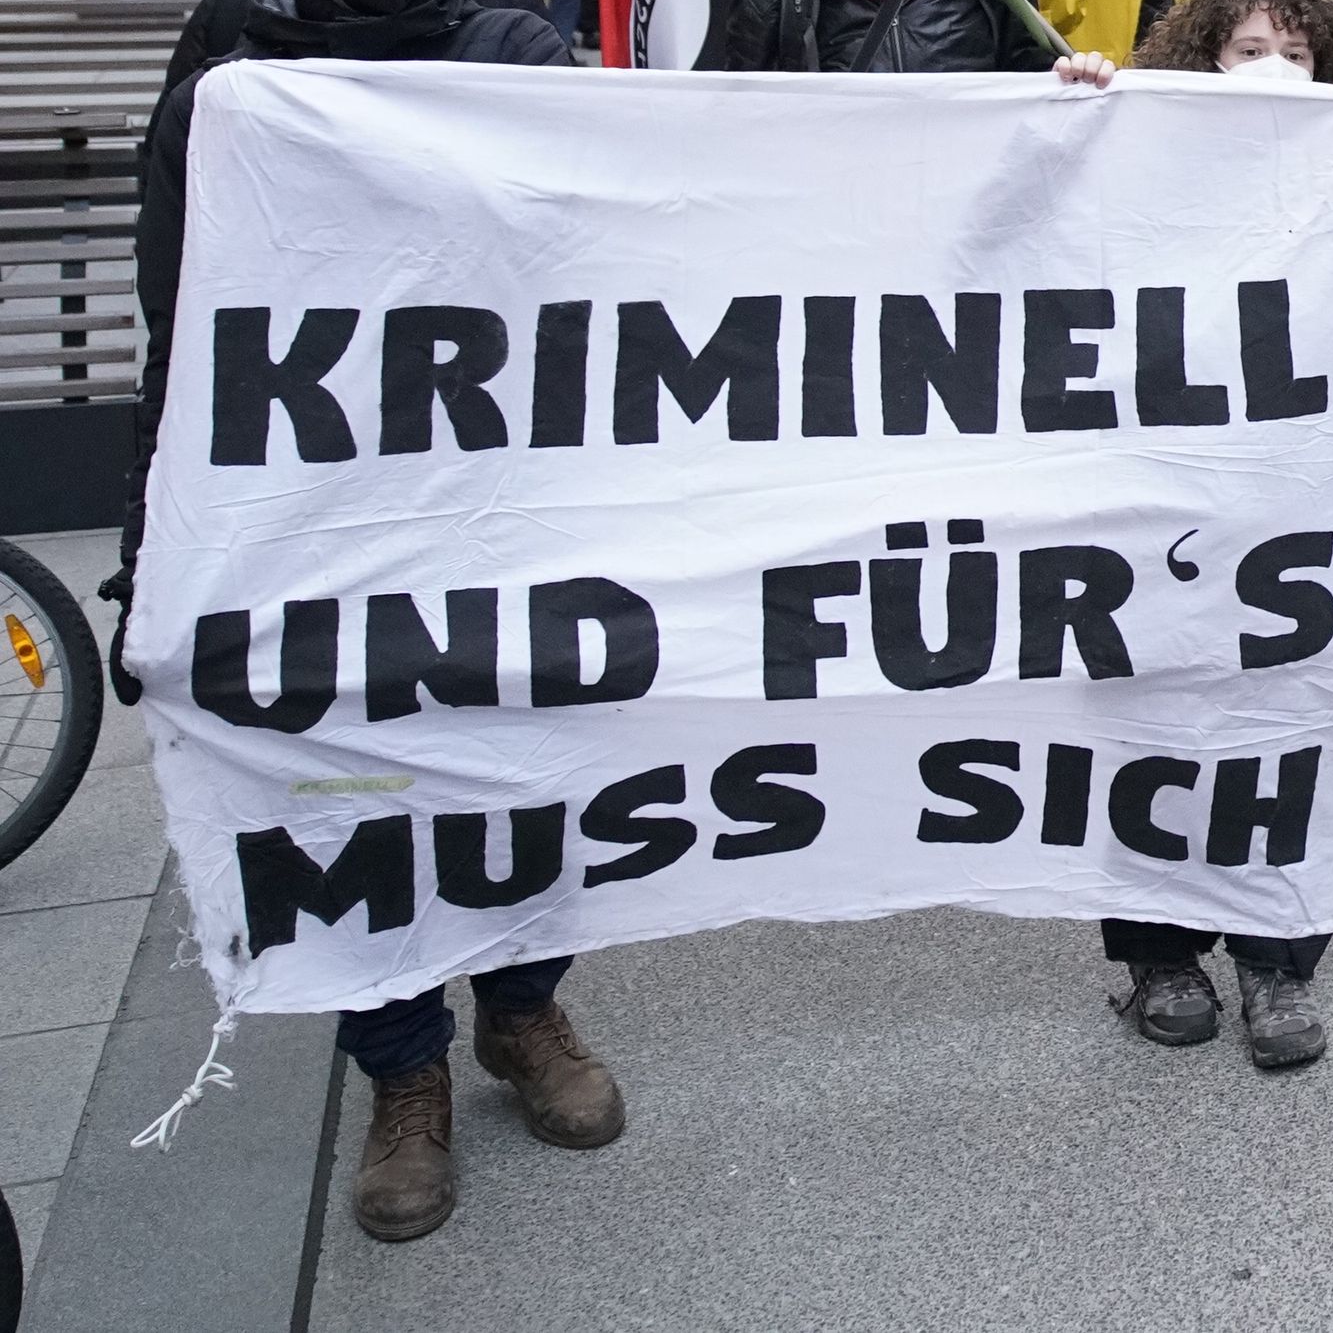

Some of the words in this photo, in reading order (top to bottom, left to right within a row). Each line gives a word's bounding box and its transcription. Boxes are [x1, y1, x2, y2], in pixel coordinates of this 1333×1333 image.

[210, 279, 1328, 466] KRIMINELL
[191, 578, 659, 734] UND
[236, 744, 825, 957] MUSS
[917, 739, 1322, 867] SICH
